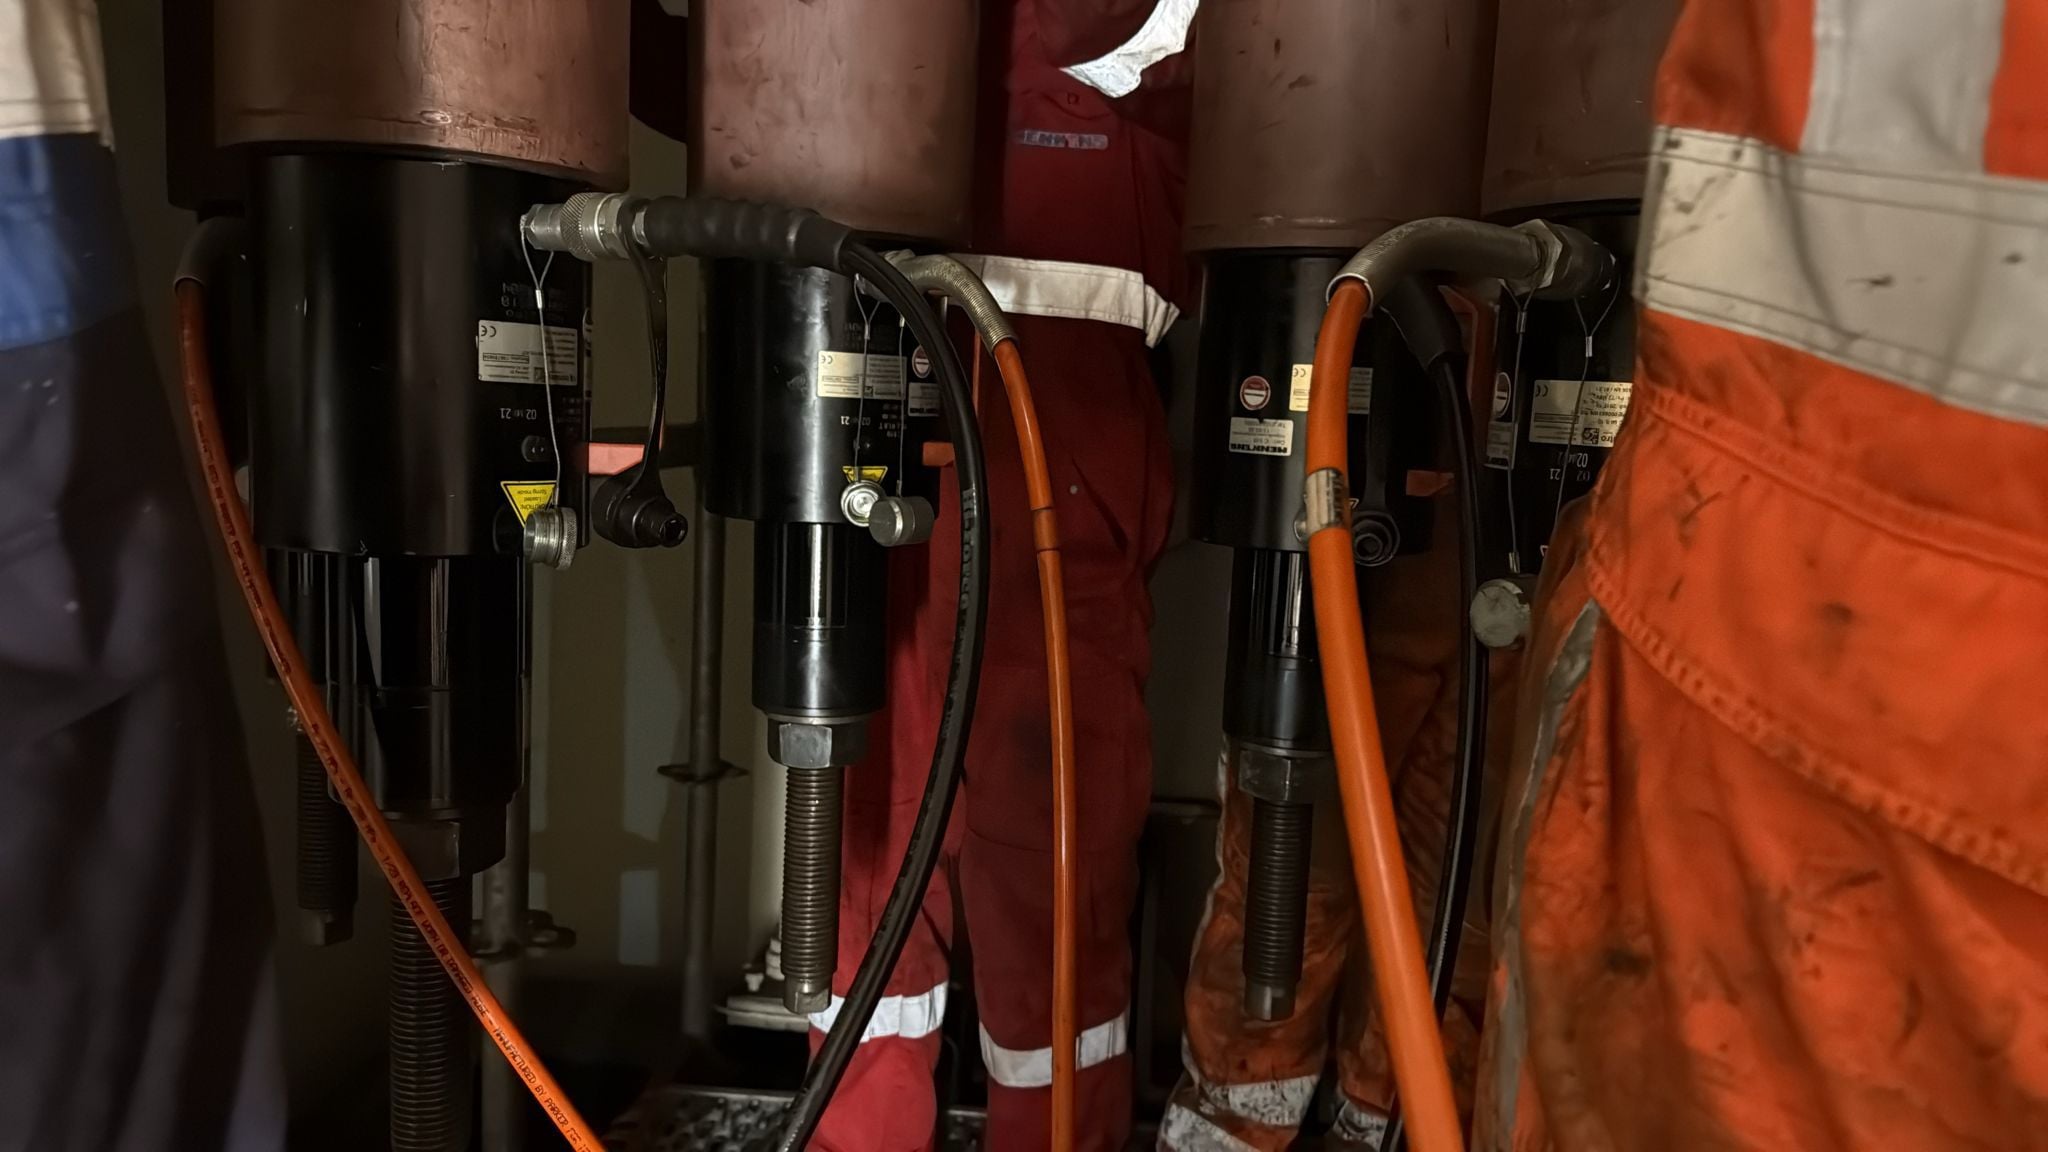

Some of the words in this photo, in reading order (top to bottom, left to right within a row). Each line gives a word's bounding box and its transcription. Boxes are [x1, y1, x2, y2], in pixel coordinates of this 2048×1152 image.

[500, 408, 512, 419] 21
[526, 409, 537, 420] 02
[840, 415, 850, 426] 21
[1600, 435, 1613, 443] tro
[1576, 453, 1588, 467] 02
[1549, 468, 1561, 480] 21
[470, 993, 490, 1017] HOSE
[492, 1026, 537, 1085] MANUFACTURED
[543, 1096, 568, 1127] PARKER
